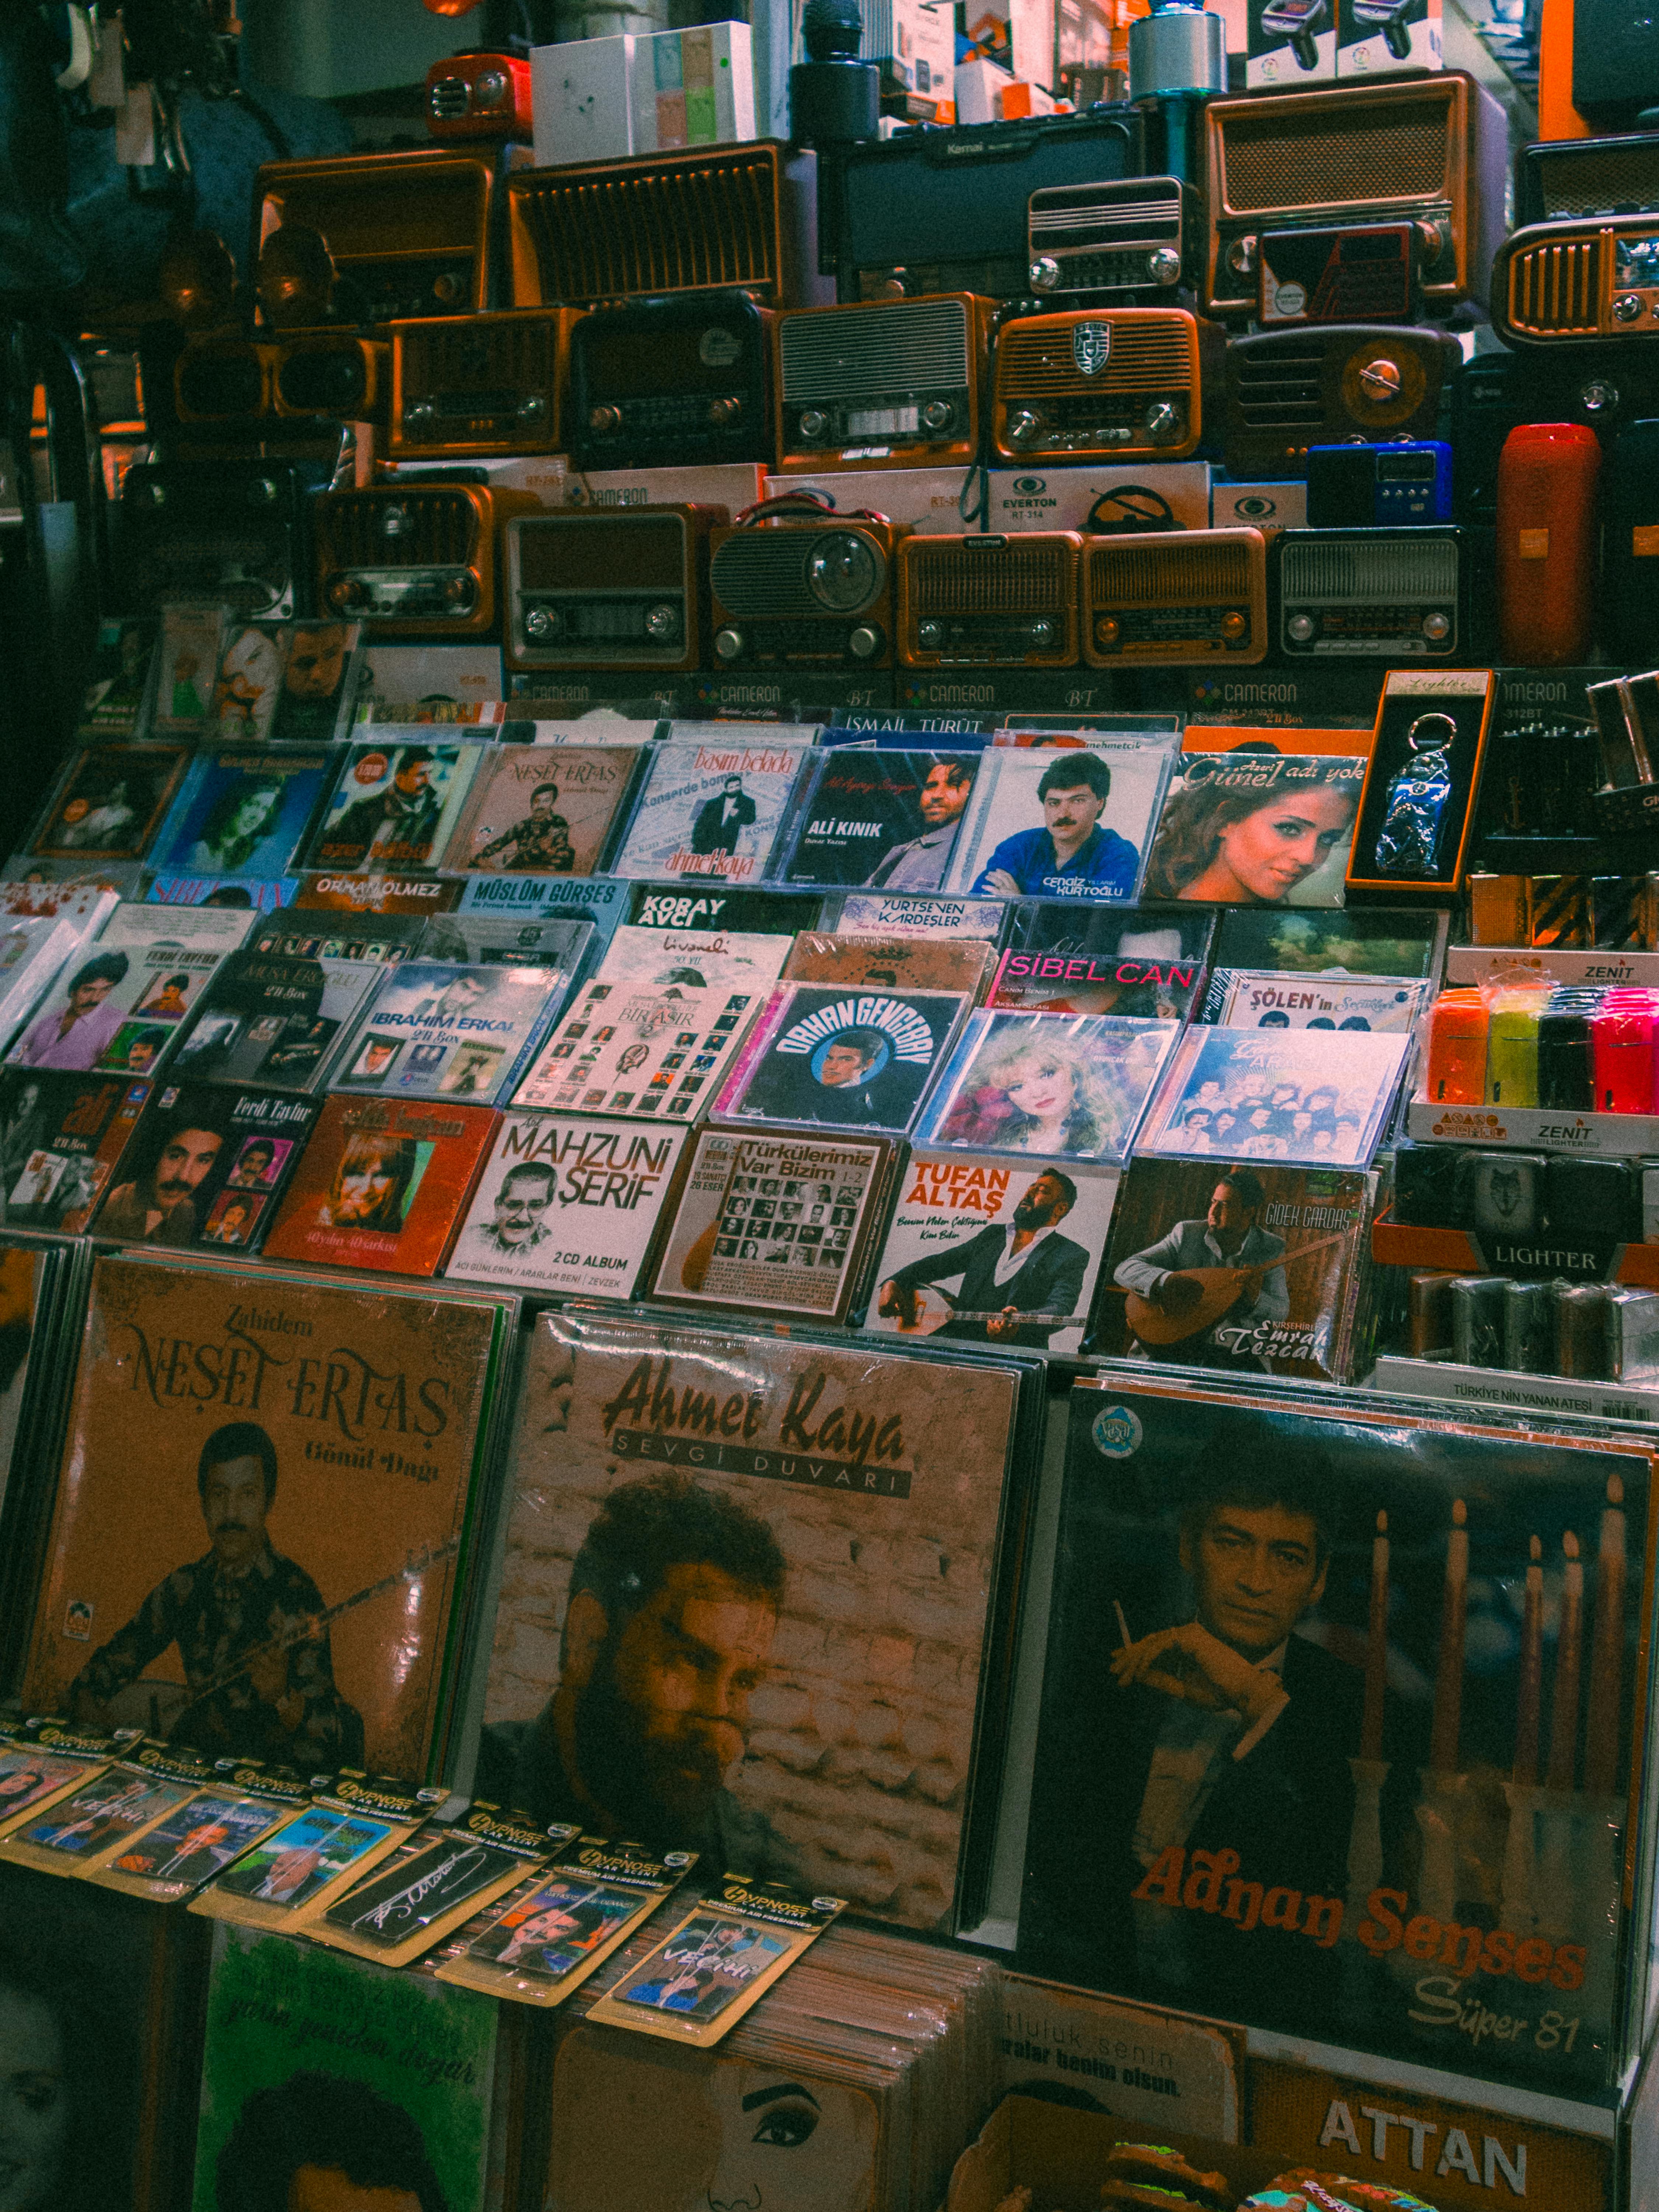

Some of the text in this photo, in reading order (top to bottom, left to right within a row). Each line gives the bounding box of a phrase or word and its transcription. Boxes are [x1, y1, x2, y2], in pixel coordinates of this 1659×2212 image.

[1003, 498, 1057, 508] EVERTON
[533, 686, 589, 700] CAMERON
[720, 686, 780, 702] CAMERON
[929, 685, 995, 702] CAMERON
[1224, 684, 1297, 702] CAMERON
[808, 817, 837, 835] ALİ
[835, 821, 883, 837] KINIK
[473, 879, 616, 904] MÜSLÜM GÜRSES
[643, 895, 726, 915] KORAY
[882, 900, 965, 914] YURTSEVEN
[878, 911, 960, 927] KARDEŞLER
[1007, 953, 1194, 988] SİBEL CAN
[855, 996, 934, 1065] GENCEBAY
[744, 1141, 873, 1167] Türkülerimiz
[740, 1157, 774, 1175] Var
[778, 1159, 836, 1181] Bizim
[914, 1162, 1011, 1191] TUFAN
[702, 1182, 723, 1192] ESER
[905, 1183, 1006, 1218] ALTAŞ
[553, 1252, 562, 1263] 2
[563, 1253, 580, 1265] CD
[1495, 1246, 1597, 1270] LIGHTER
[588, 1276, 620, 1288] ZEVZEK
[121, 1323, 450, 1450] NEŞET ERTAŞ
[1522, 1392, 1559, 1407] YANAN
[780, 1372, 905, 1464] Kaya
[616, 1434, 896, 1491] SEVGİ DUVARI
[1130, 1844, 1345, 1949] Adnan
[1407, 1975, 1580, 2053] Süper 81
[1056, 2048, 1117, 2081] benim
[1099, 2037, 1174, 2069] senin
[1319, 2099, 1527, 2198] ATTAN
